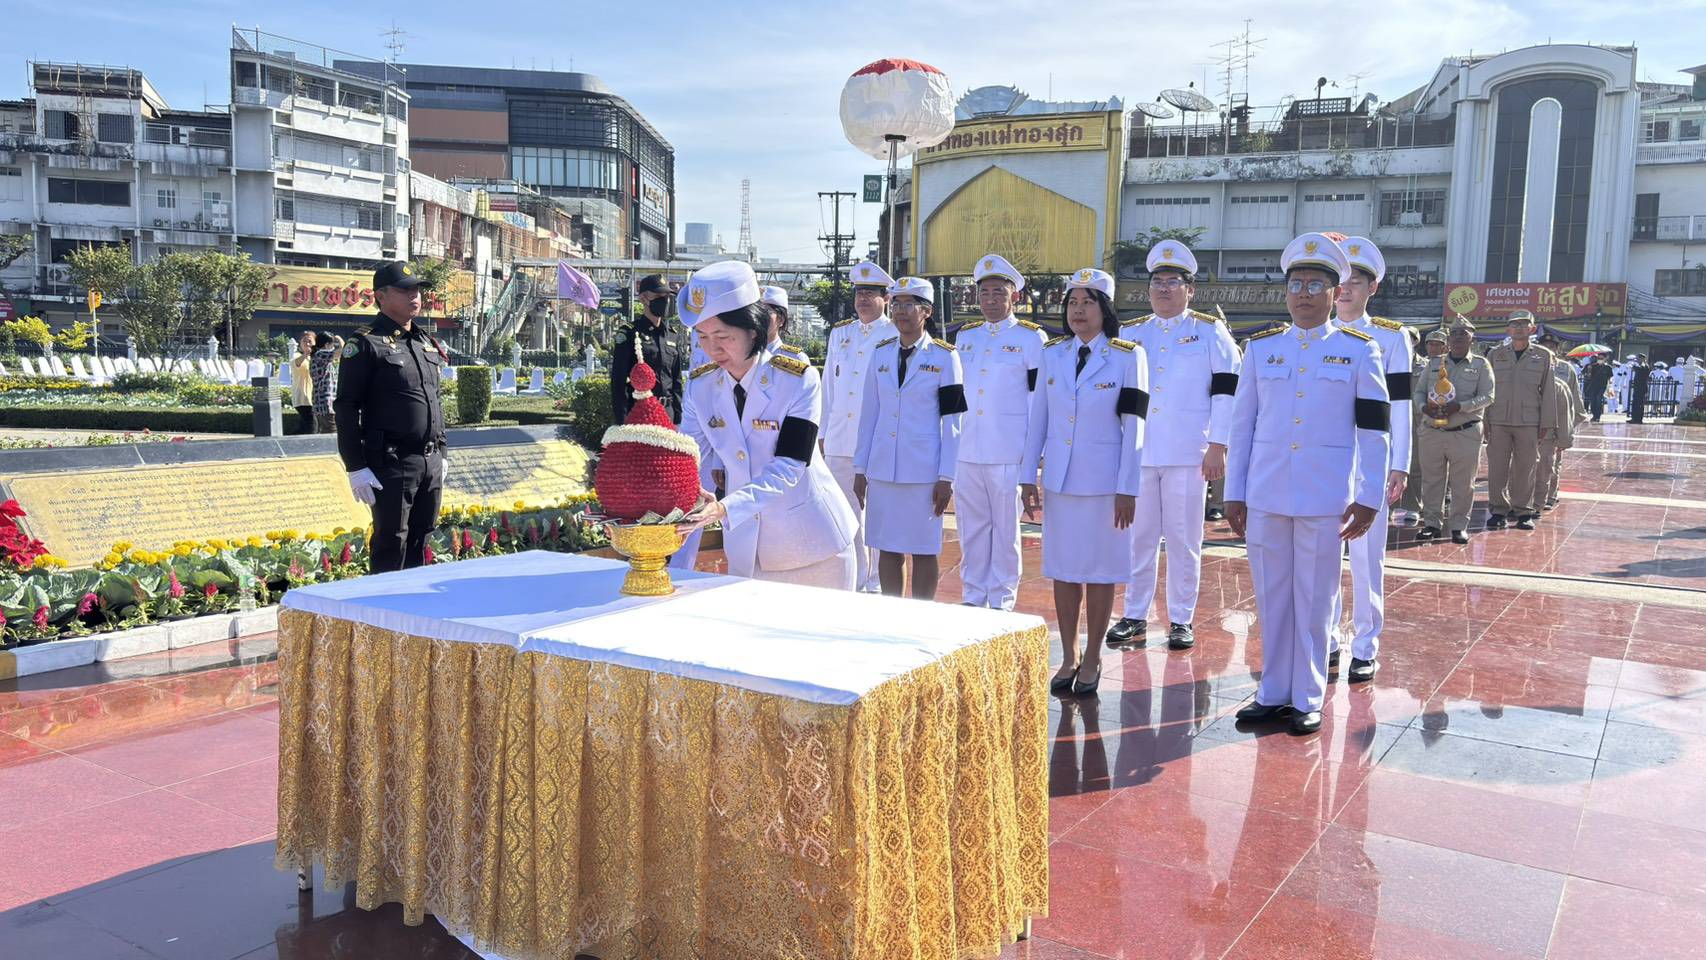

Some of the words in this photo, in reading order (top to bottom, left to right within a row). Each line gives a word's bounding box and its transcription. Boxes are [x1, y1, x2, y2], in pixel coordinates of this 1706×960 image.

[1486, 287, 1530, 297] เศษทอง
[1536, 287, 1558, 305] ให้
[1558, 285, 1590, 315] สูง
